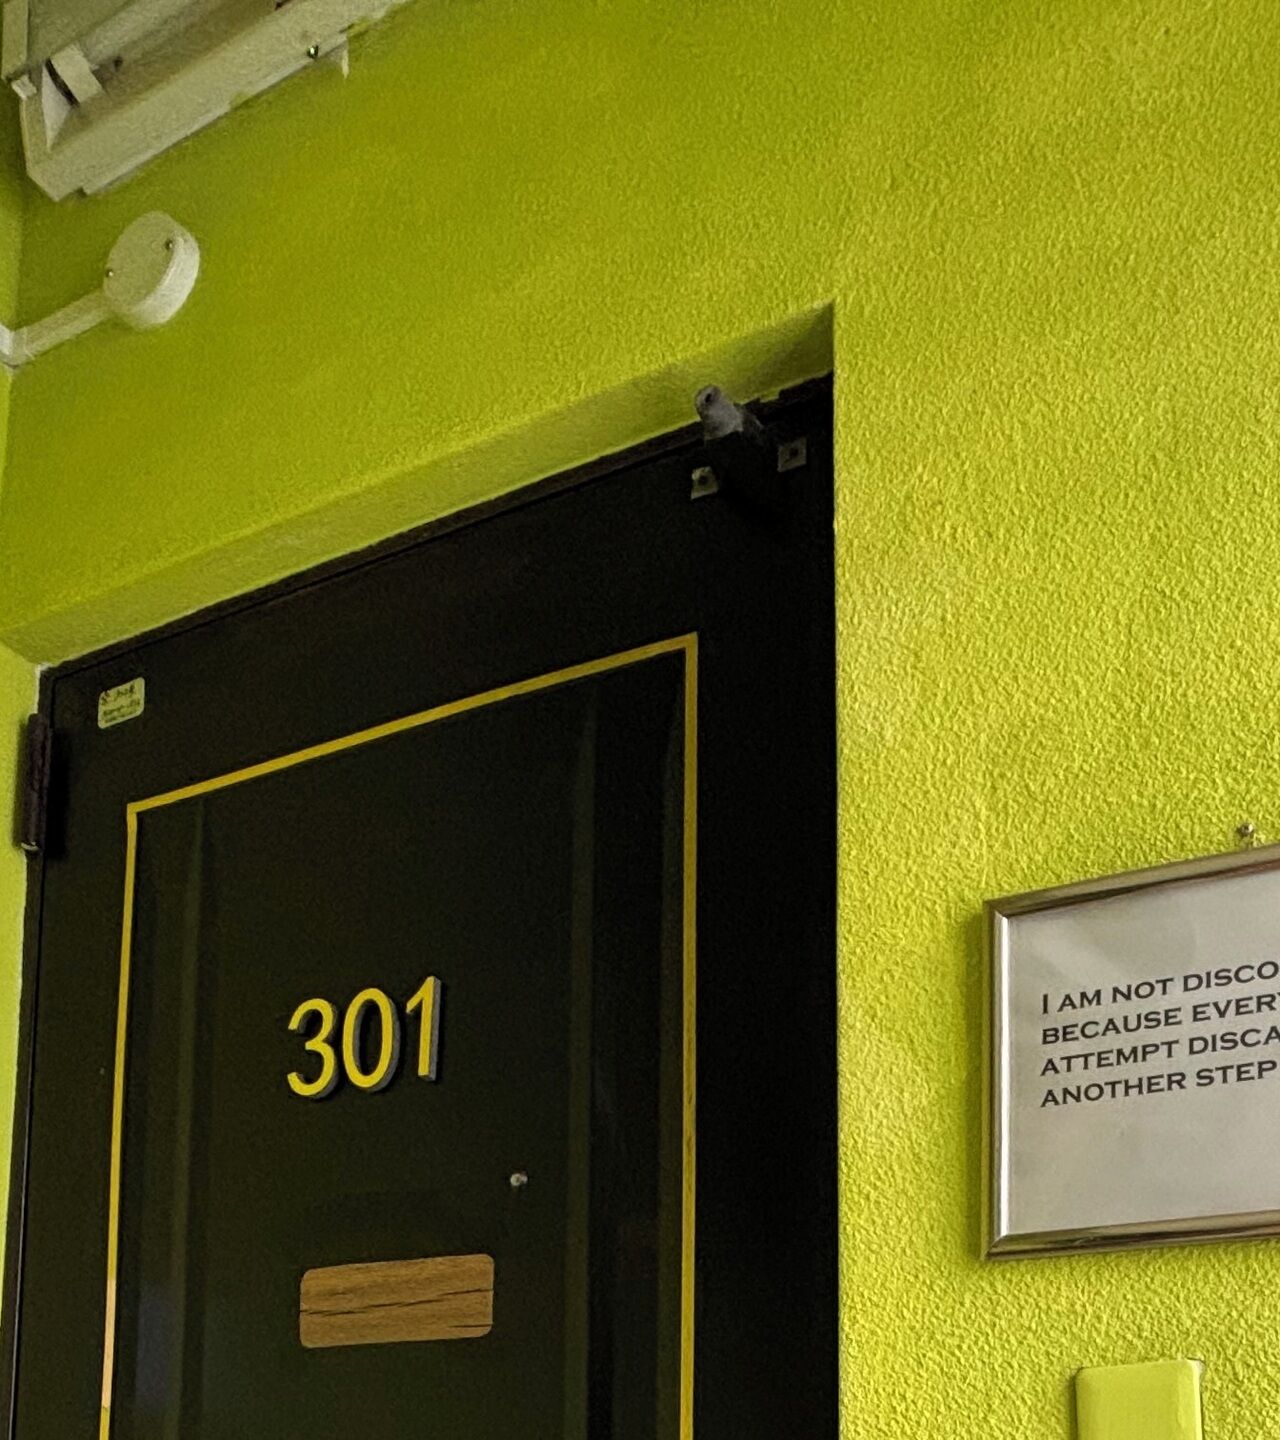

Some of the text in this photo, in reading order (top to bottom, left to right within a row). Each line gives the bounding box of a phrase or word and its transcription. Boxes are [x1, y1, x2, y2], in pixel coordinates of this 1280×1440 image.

[1041, 993, 1049, 1015] I
[1056, 988, 1102, 1013] AM
[1111, 977, 1175, 1004] NOT
[286, 975, 442, 1099] 301
[1041, 1006, 1183, 1046] BECAUSE
[1039, 1039, 1180, 1077] ATTEMPT
[1039, 1071, 1187, 1108] ANOTHER
[1195, 1059, 1278, 1088] STEP
